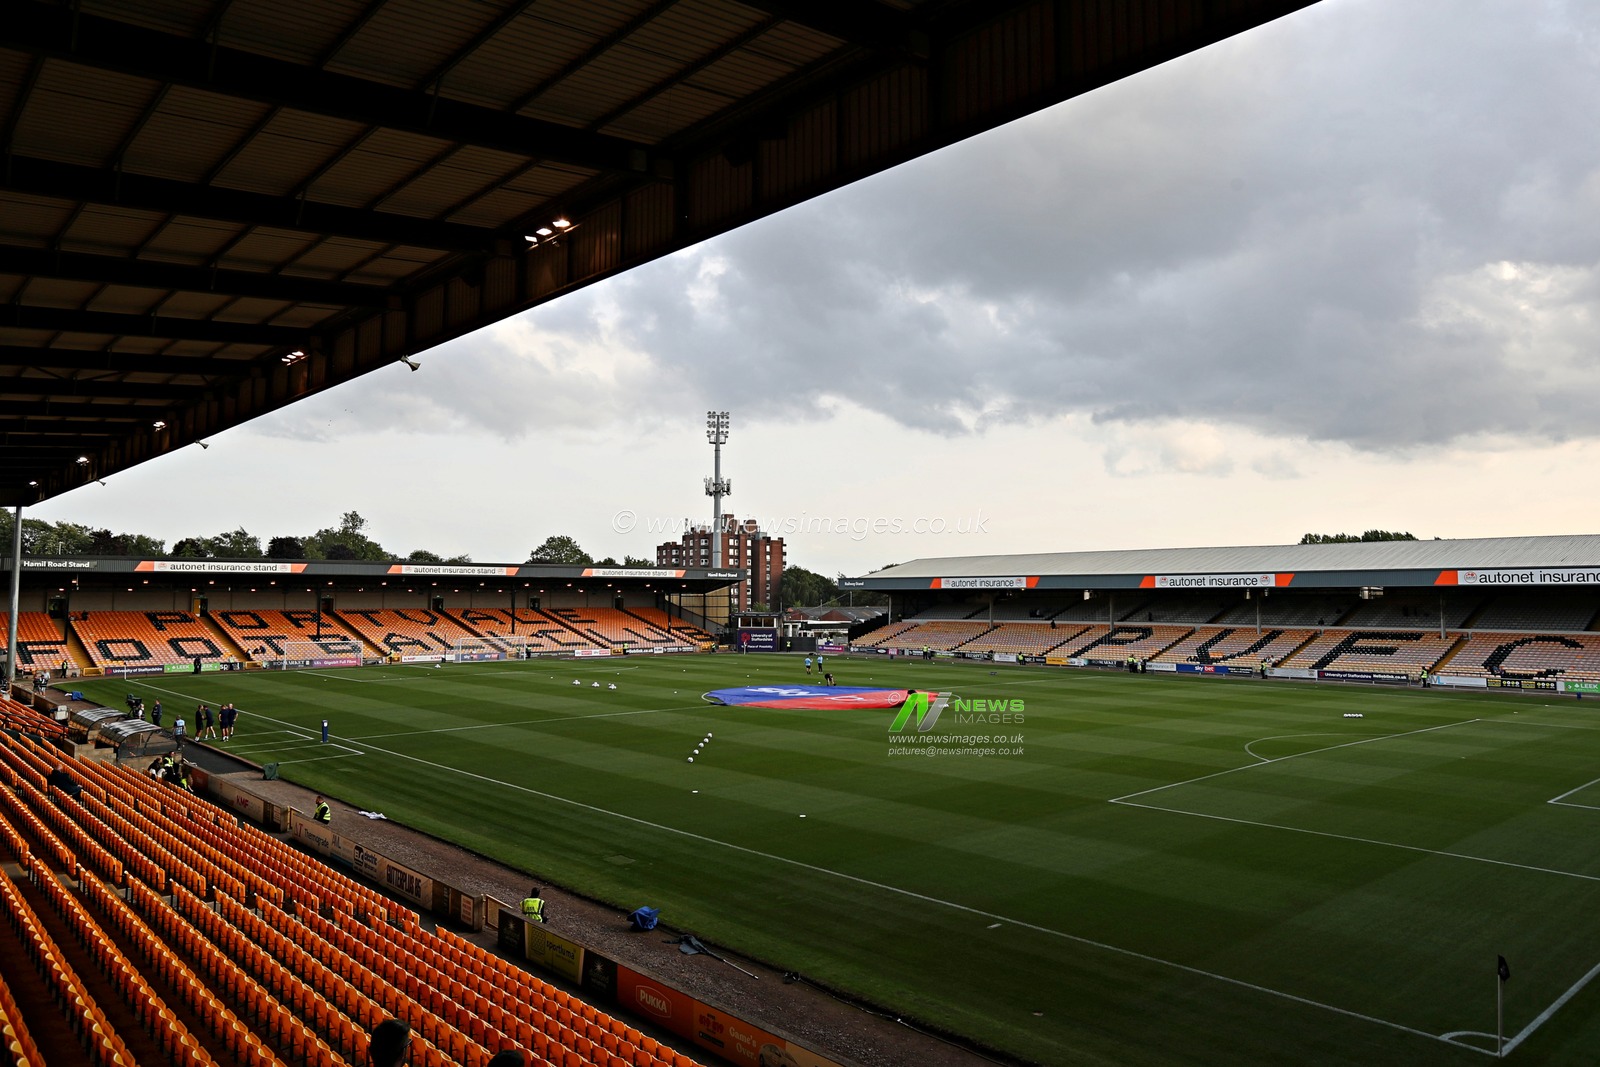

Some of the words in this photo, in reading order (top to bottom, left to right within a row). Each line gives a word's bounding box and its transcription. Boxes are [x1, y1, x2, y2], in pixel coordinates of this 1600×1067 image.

[170, 563, 206, 571] autonet
[208, 563, 251, 571] insurance
[1169, 577, 1206, 587] autonet
[1208, 576, 1258, 586] insurance
[1479, 571, 1534, 583] autonet
[951, 579, 978, 588] autonet
[979, 578, 1014, 587] insurance
[112, 667, 133, 675] University
[640, 989, 668, 1014] PUKKA
[729, 1025, 757, 1047] Game's
[735, 1042, 757, 1061] Over.
